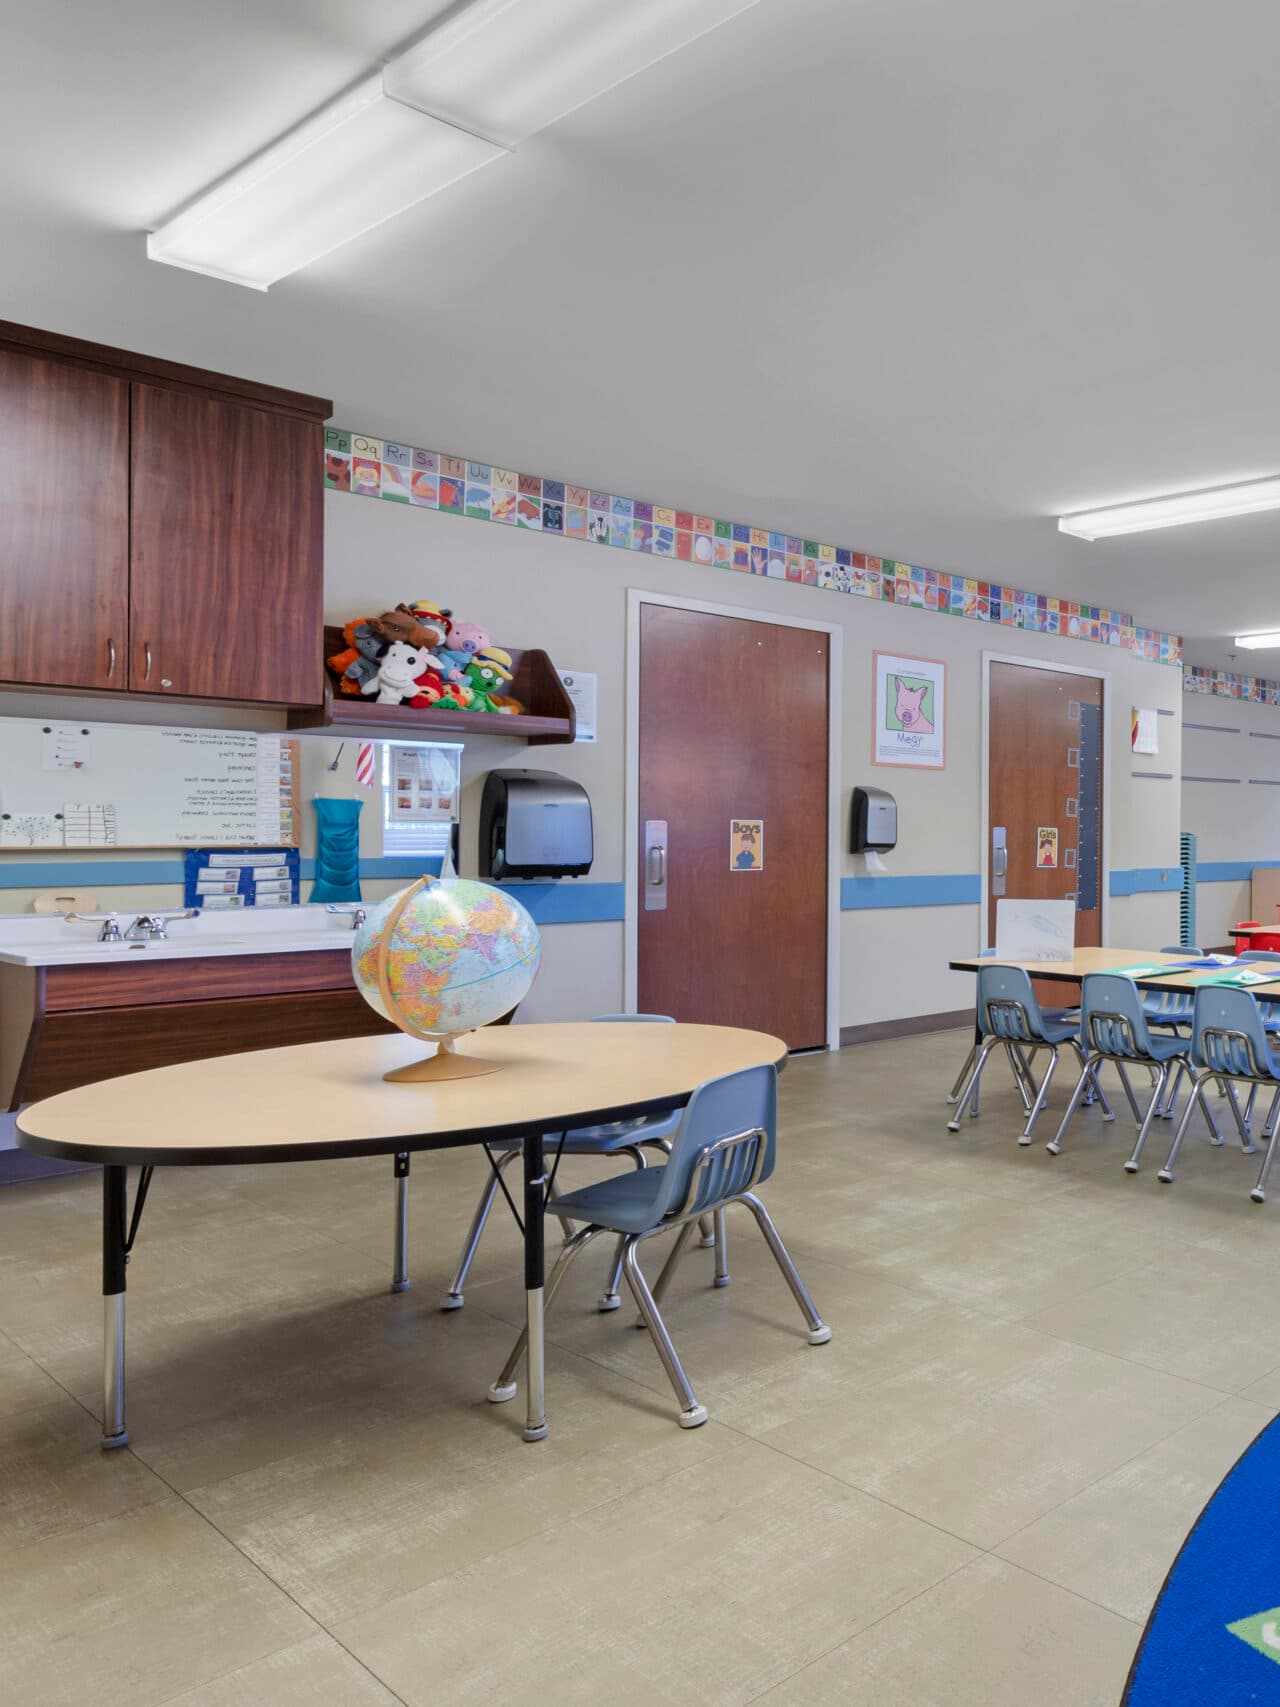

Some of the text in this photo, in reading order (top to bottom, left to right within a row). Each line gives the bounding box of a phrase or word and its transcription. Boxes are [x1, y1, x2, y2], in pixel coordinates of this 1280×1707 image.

[326, 430, 348, 450] Pp
[354, 438, 381, 460] Qq
[387, 444, 407, 460] Rr
[416, 452, 433, 467] Ss
[445, 458, 461, 473] Tt
[470, 463, 489, 480] Uu
[497, 471, 513, 485] Vv
[520, 477, 542, 491] Ww
[569, 488, 585, 506] Yy
[592, 493, 608, 507] Zz
[613, 500, 631, 513] Aa
[656, 509, 672, 521] Cc
[697, 519, 711, 530] Ee
[897, 733, 923, 748] Megy
[732, 821, 761, 834] Boys
[1039, 829, 1057, 840] Girls
